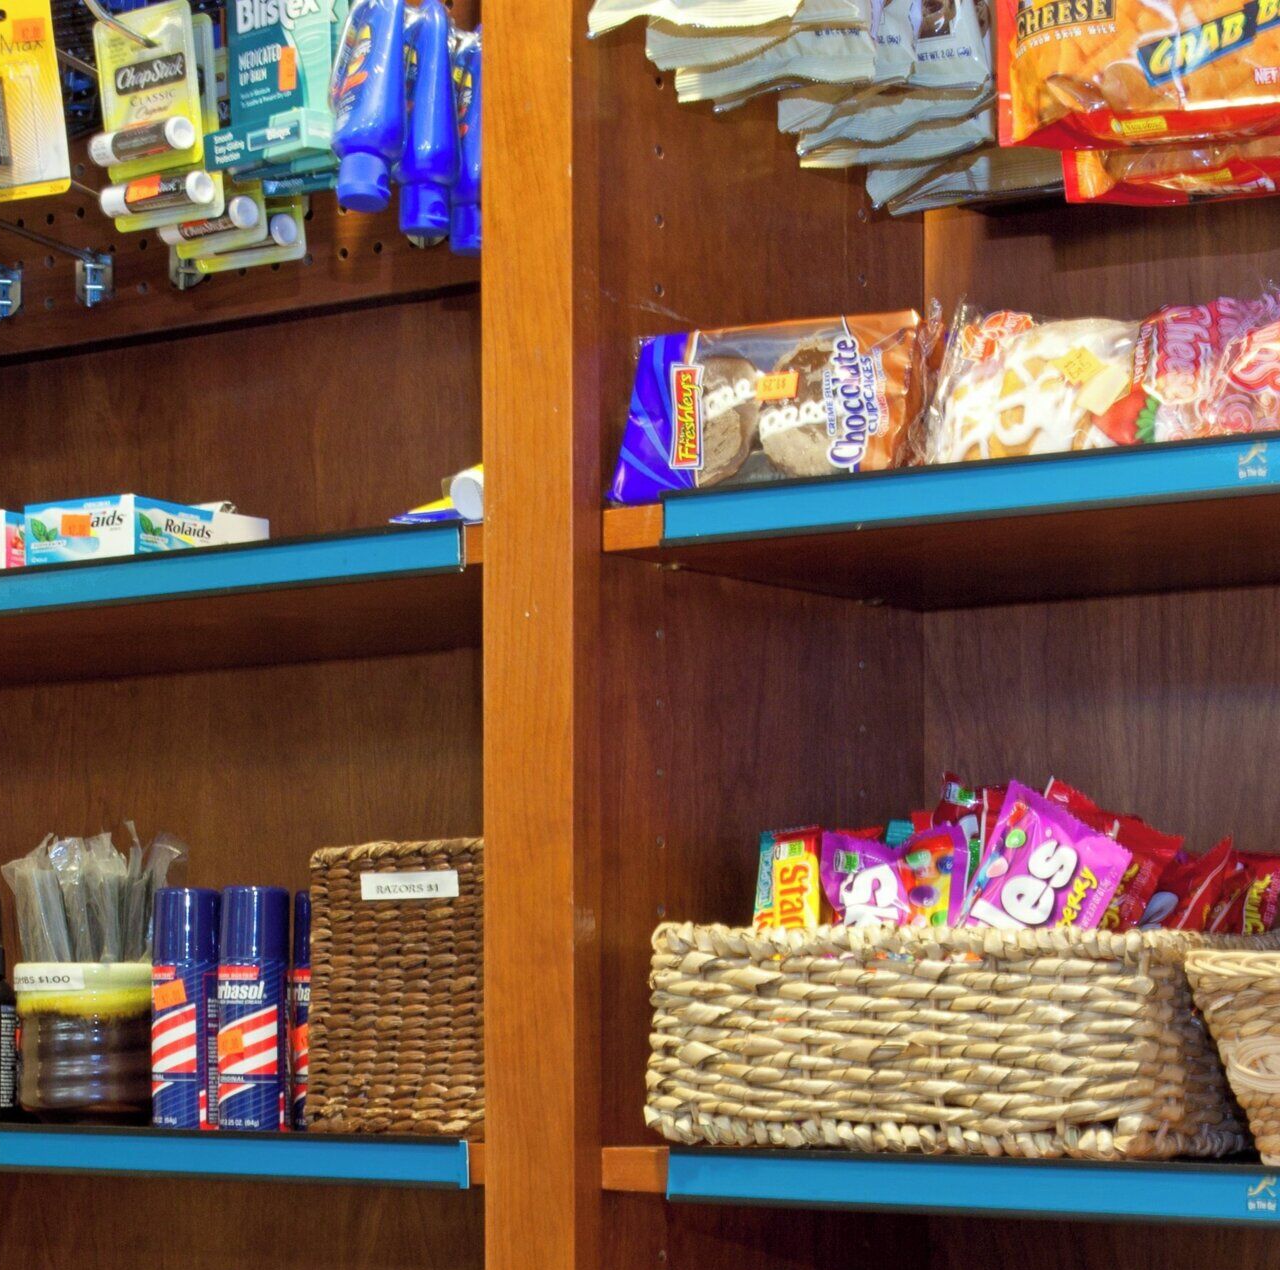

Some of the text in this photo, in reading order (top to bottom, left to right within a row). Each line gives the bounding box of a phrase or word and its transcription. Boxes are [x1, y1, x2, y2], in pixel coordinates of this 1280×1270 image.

[1148, 12, 1246, 76] GRAB
[1255, 67, 1279, 84] NET
[828, 338, 865, 466] Chocolate
[863, 356, 878, 434] CUPCAKES
[165, 519, 211, 538] Rolaids
[376, 883, 423, 894] RAZORS
